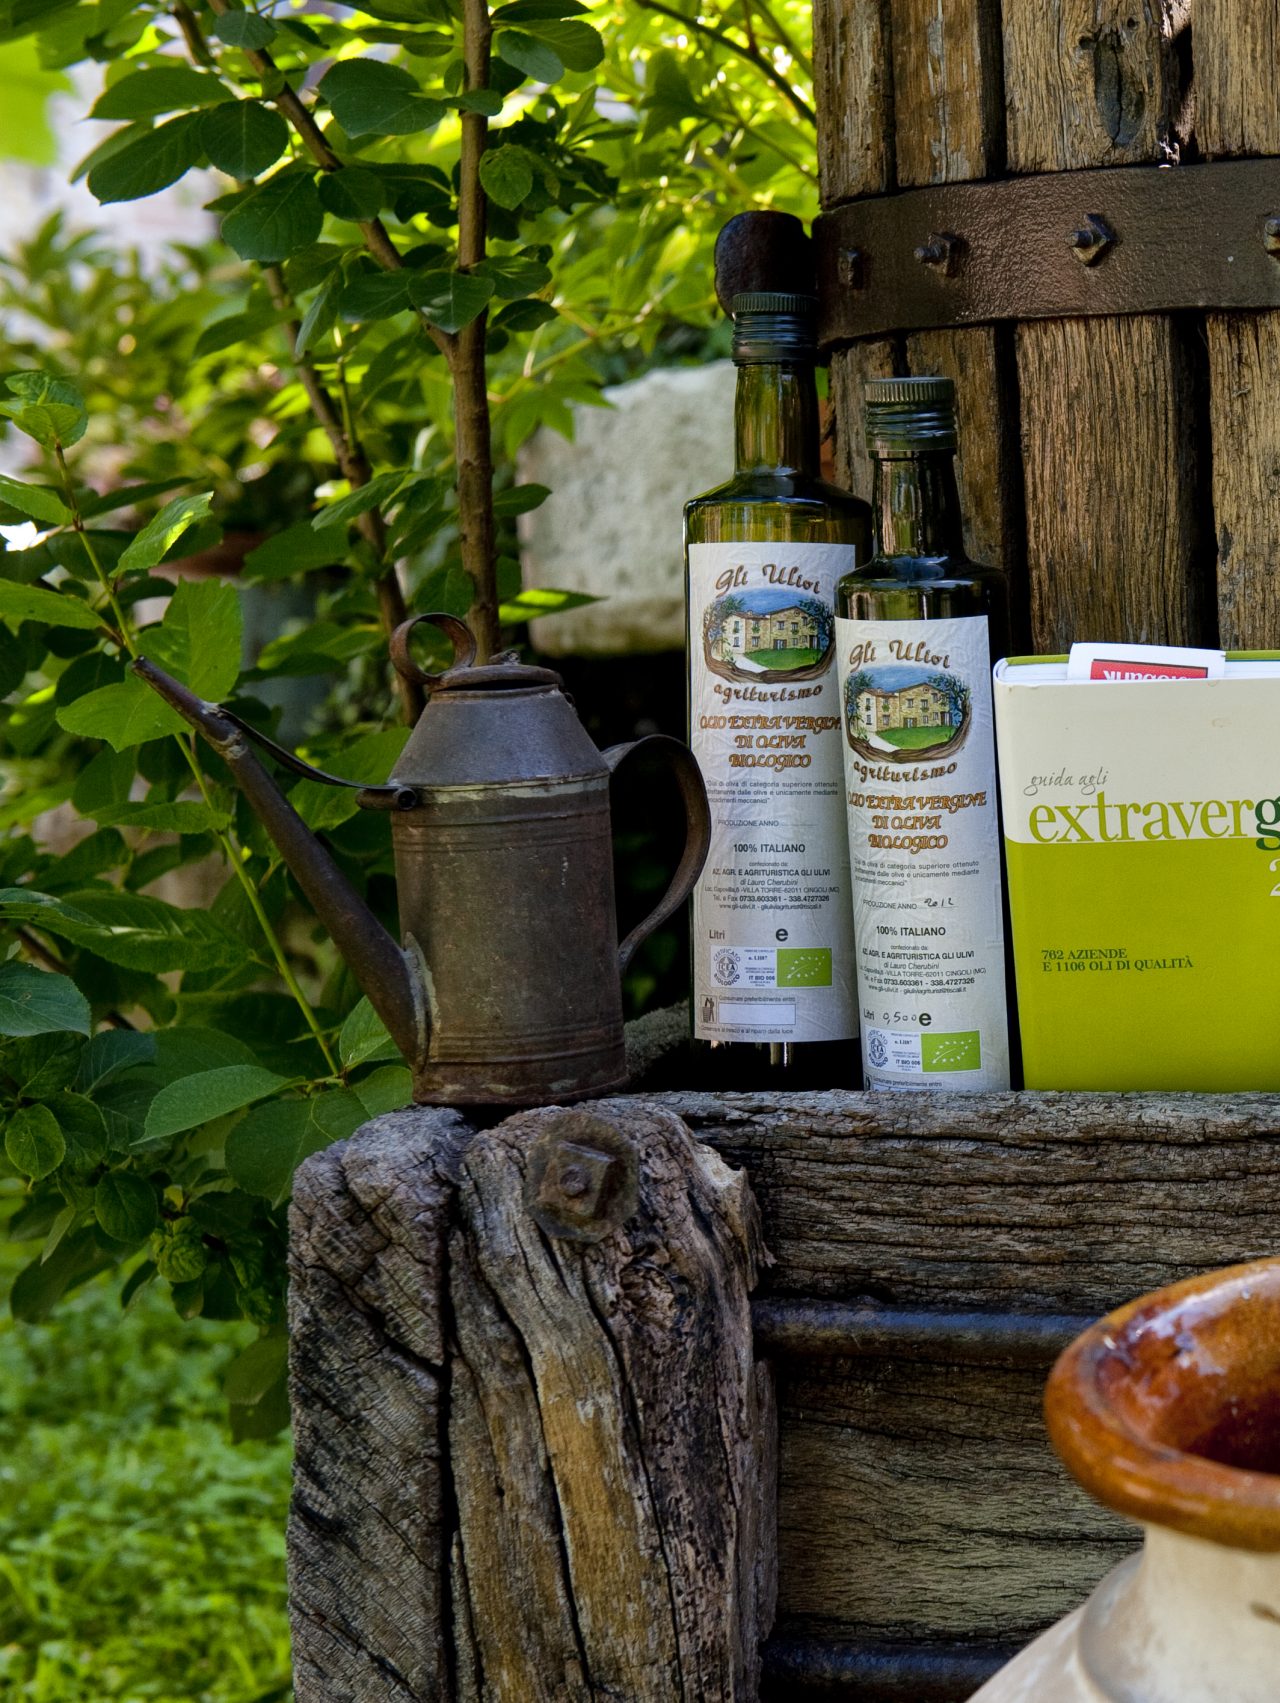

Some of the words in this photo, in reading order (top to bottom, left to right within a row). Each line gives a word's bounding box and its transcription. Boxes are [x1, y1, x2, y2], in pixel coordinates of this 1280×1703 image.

[715, 565, 748, 599] Gli
[762, 563, 821, 594] Ulivi
[849, 641, 876, 672] Gli
[889, 640, 951, 669] Ulivi
[714, 683, 824, 704] agriturismo
[700, 715, 727, 729] OLIO
[728, 715, 783, 729] EXTRA
[783, 716, 842, 735] VERGIN
[735, 735, 753, 749] DI
[756, 734, 806, 749] OLIVA
[729, 754, 812, 773] BIOLOGICO
[853, 761, 957, 783] agriturismo
[750, 781, 779, 789] categoria
[782, 781, 813, 789] superiore
[1023, 767, 1074, 796] guida
[1078, 767, 1109, 795] agli
[866, 795, 916, 811] EXTRA
[916, 791, 987, 814] VERGINE
[872, 815, 889, 829] DI
[891, 815, 942, 830] OLIVA
[733, 844, 758, 853] 100%
[760, 844, 806, 853] ITALIANO
[868, 834, 949, 855] BIOLOGICO
[887, 862, 916, 871] categoria
[918, 862, 950, 871] superiore
[952, 860, 980, 868] ottenuto
[877, 870, 890, 878] dalle
[951, 869, 980, 877] mediante
[863, 899, 896, 909] PRODUZIONE
[897, 902, 917, 910] ANNO
[709, 929, 725, 940] Litri
[775, 928, 789, 942] e
[876, 925, 898, 936] 100%
[900, 927, 946, 936] ITALIANO
[886, 952, 941, 960] AGRITURISTICA
[942, 952, 955, 960] GLI
[956, 950, 975, 959] ULIVI
[1041, 949, 1065, 960] 762
[1067, 948, 1128, 960] AZIENDE
[908, 962, 940, 970] Cherubini
[1042, 961, 1052, 972] E
[1056, 960, 1086, 972] 1106
[1089, 960, 1114, 972] OLI
[1116, 959, 1132, 971] DI
[1134, 954, 1194, 971] QUALITÀ
[945, 968, 973, 977] CINGOLI
[930, 977, 975, 987] 338.4727326
[863, 1008, 875, 1021] Litri
[918, 1012, 932, 1027] e
